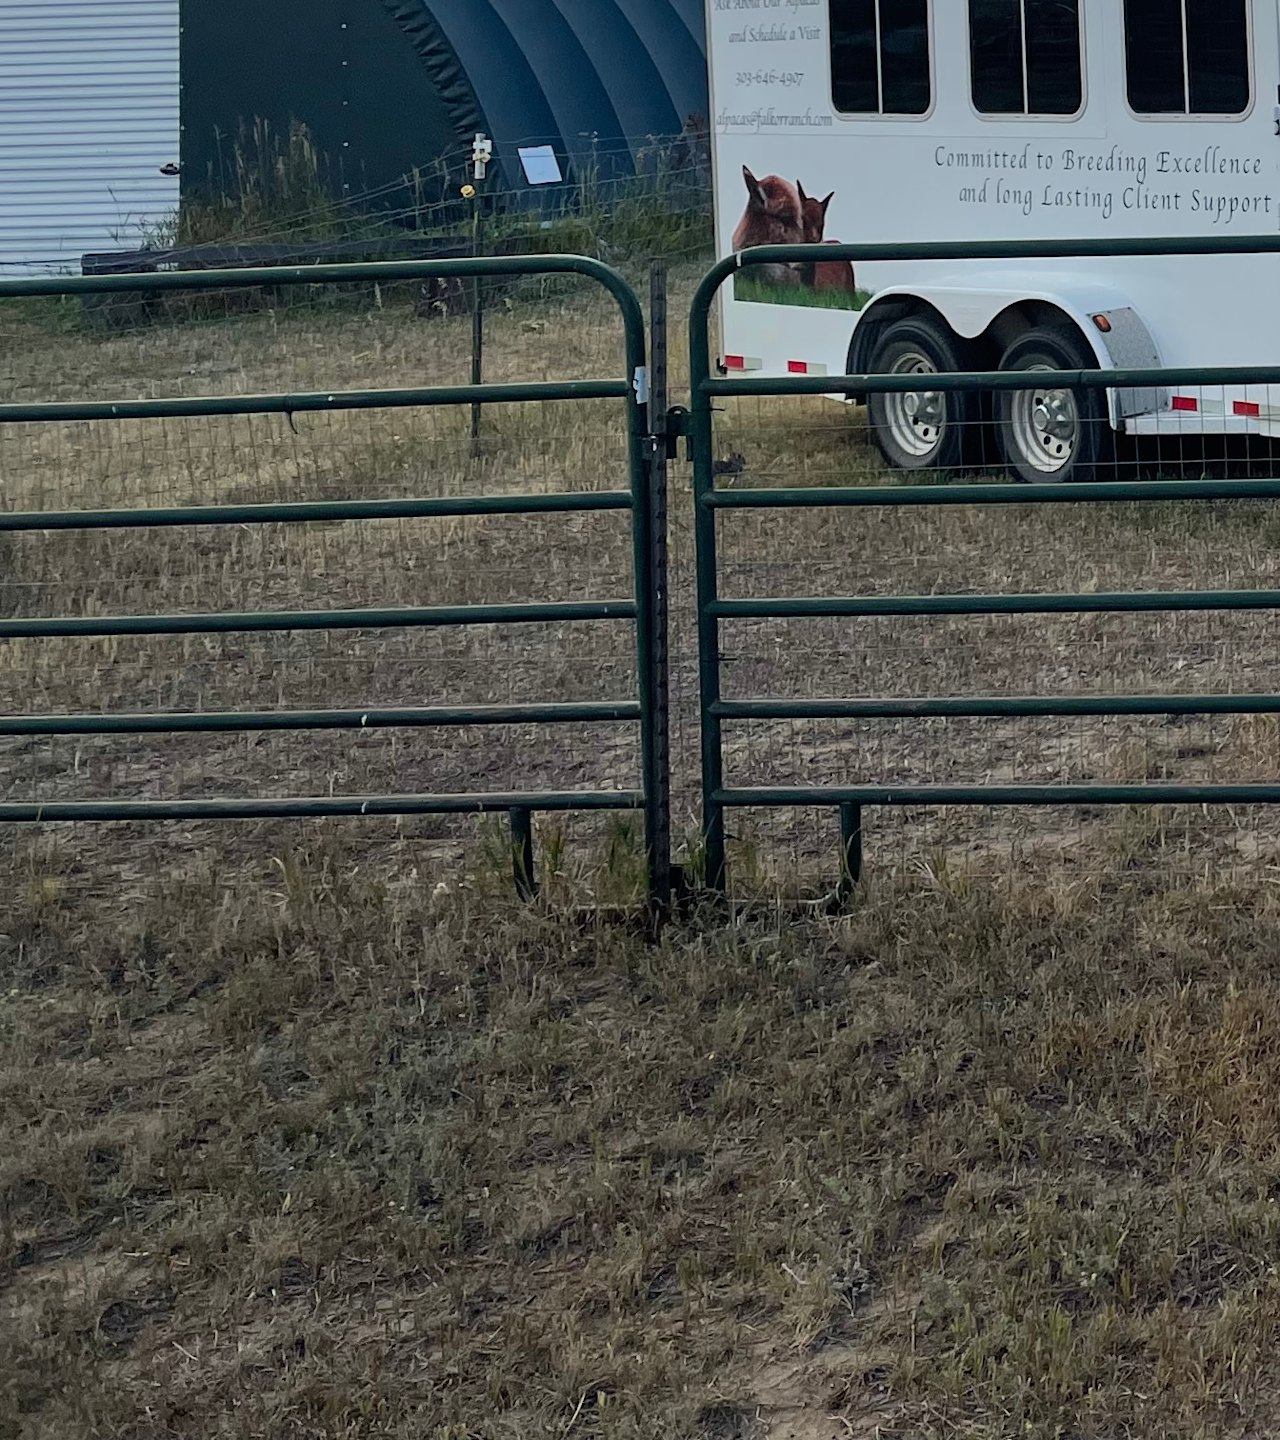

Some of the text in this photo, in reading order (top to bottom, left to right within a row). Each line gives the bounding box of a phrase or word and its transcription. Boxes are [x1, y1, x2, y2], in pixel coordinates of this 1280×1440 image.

[729, 22, 821, 43] and Schedule a Visit
[735, 68, 804, 87] 303-646-4907
[934, 143, 1262, 184] Committed to Breeding Excellence
[959, 177, 1272, 224] and long Lasting Client Support
